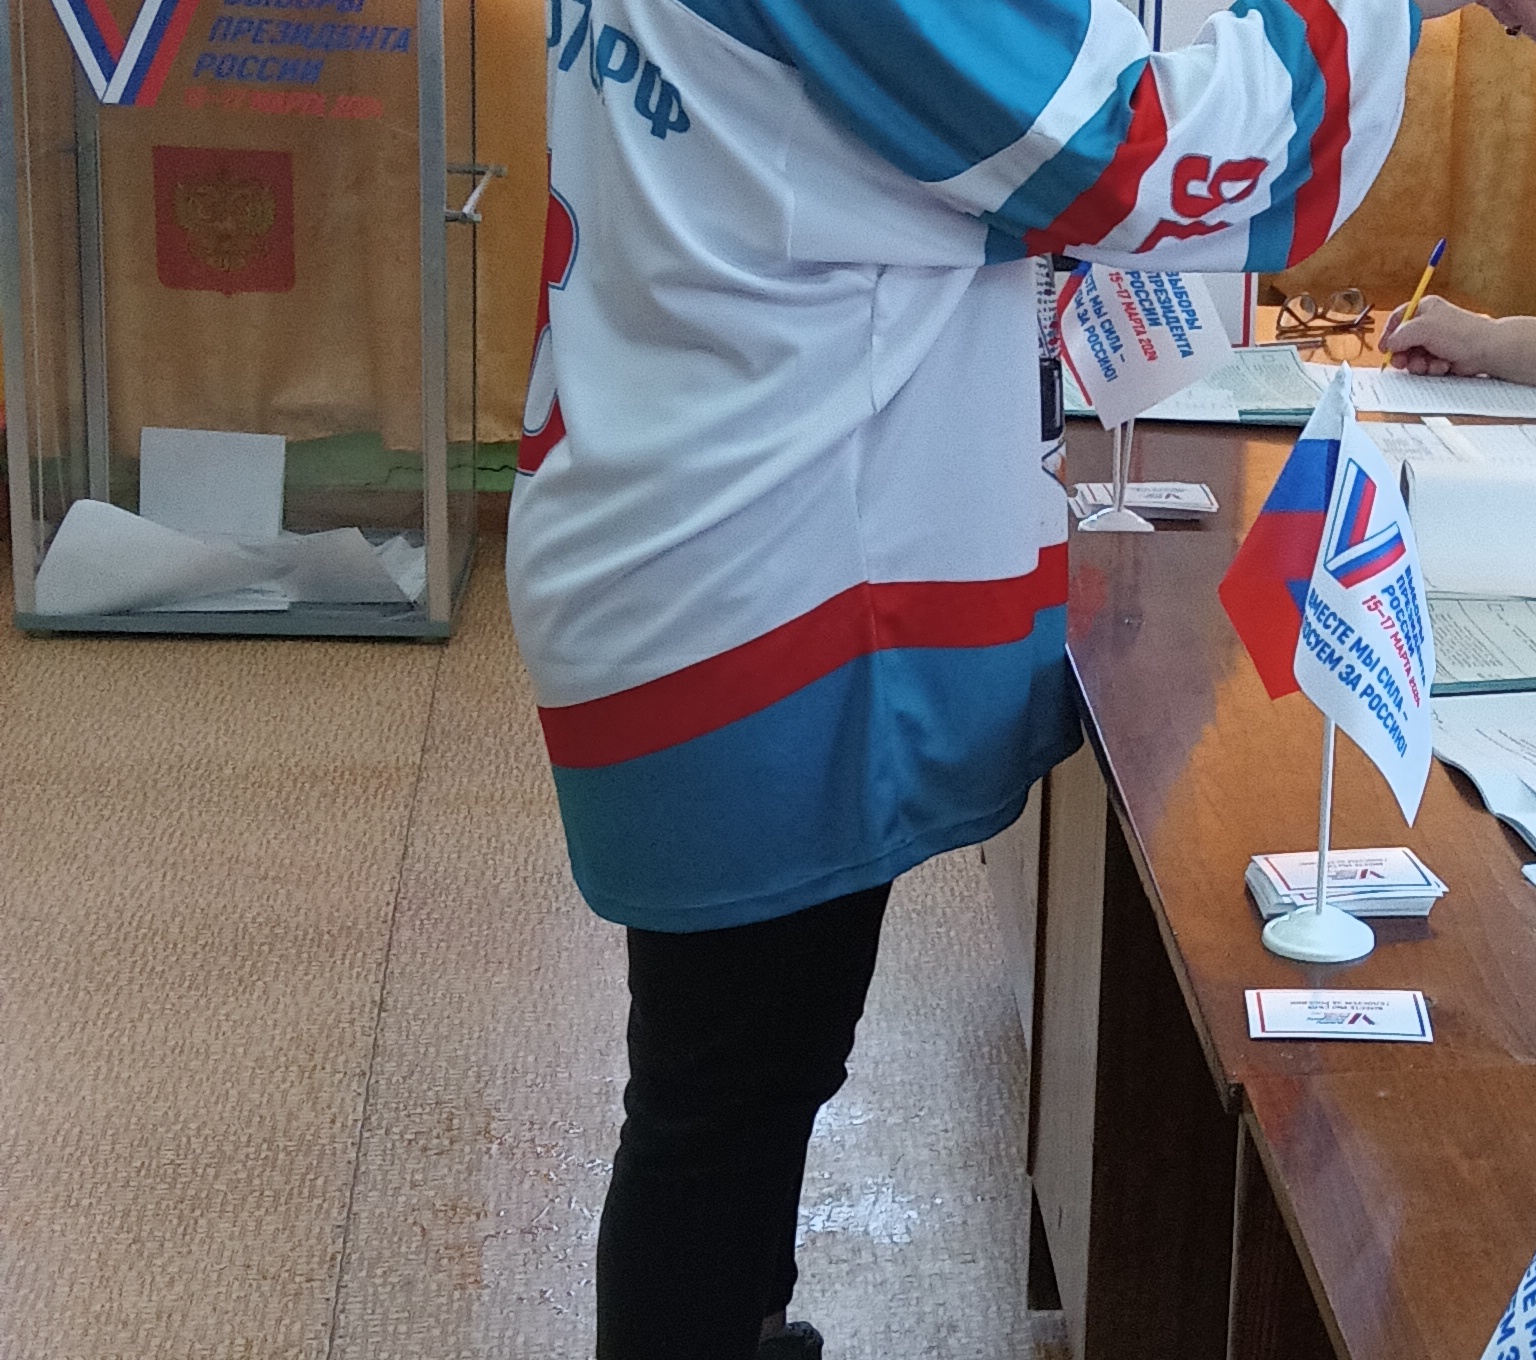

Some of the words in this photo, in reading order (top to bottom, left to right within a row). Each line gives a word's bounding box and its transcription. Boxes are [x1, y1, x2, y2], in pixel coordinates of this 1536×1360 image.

[208, 15, 412, 54] ПРЕЗИДЕНТА
[193, 51, 325, 85] РОССИИ
[1089, 294, 1108, 319] МЫ
[1100, 318, 1124, 354] СИЛА
[1121, 301, 1148, 337] МАРТА
[1125, 270, 1163, 327] РОССИИ
[1077, 308, 1091, 327] ЗА
[1084, 324, 1119, 383] РОССИЮ!
[1381, 584, 1415, 658] РОССИИ
[1349, 635, 1381, 673] МЫ
[1377, 665, 1405, 713] СИЛА
[1389, 631, 1413, 678] МАРТА
[1337, 663, 1363, 692] ЗА
[1358, 683, 1408, 758] РОССИЮ!
